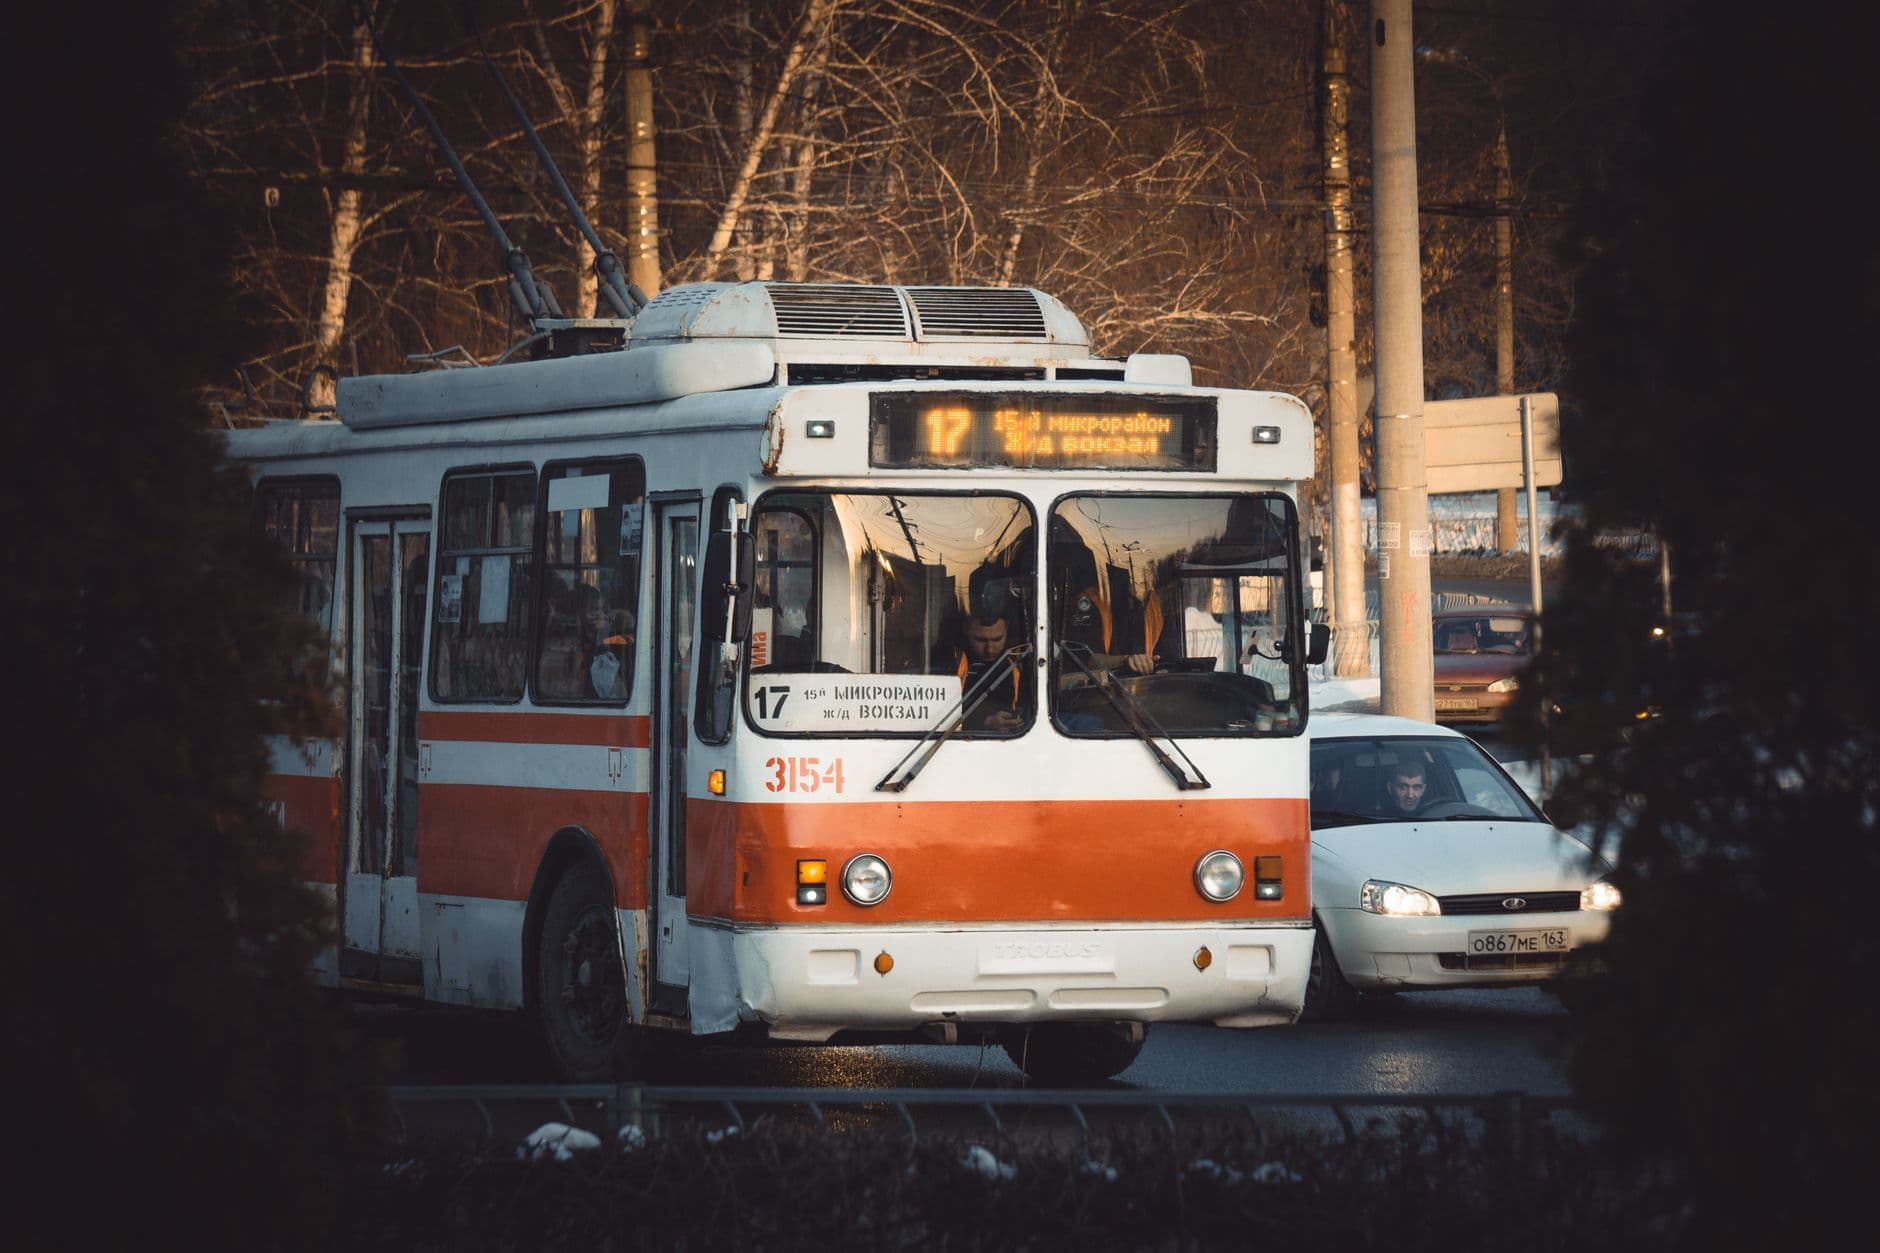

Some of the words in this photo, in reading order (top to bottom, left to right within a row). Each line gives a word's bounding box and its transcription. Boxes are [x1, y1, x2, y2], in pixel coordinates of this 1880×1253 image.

[926, 408, 970, 454] 17
[754, 686, 790, 719] 17
[834, 684, 946, 700] МИКРОРАЙОН
[859, 705, 929, 719] ВОКЗАЛ
[765, 757, 845, 794] 3154
[1541, 931, 1564, 945] 163
